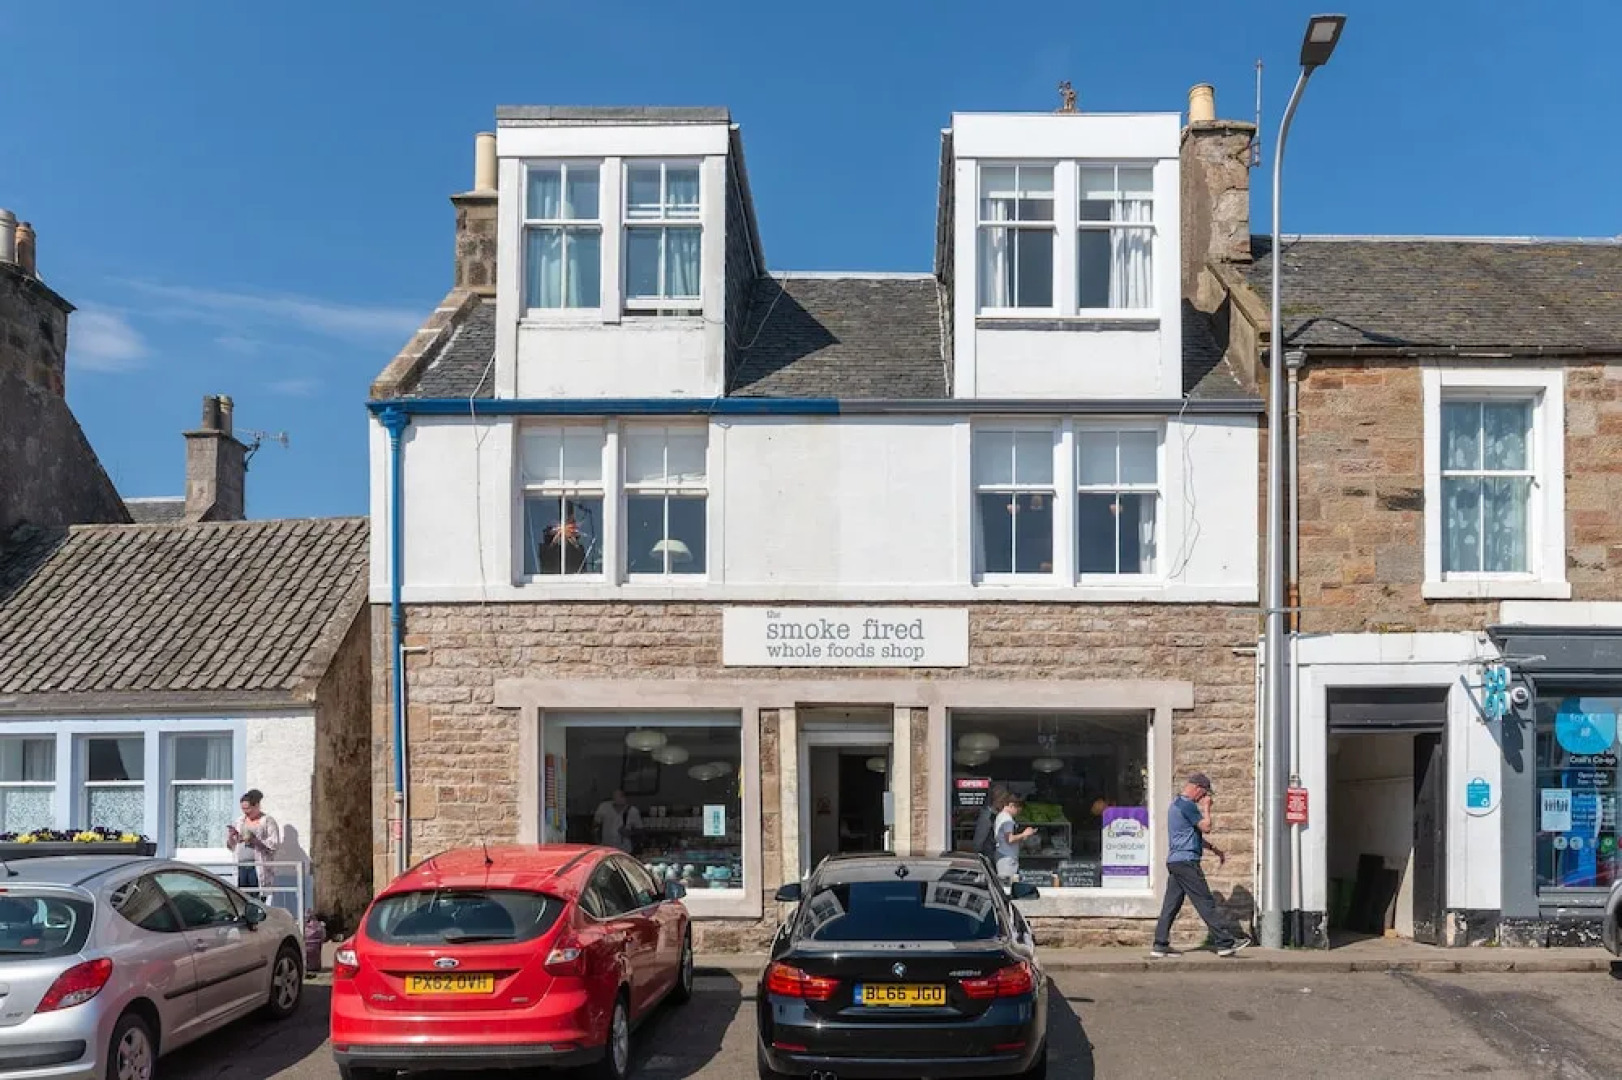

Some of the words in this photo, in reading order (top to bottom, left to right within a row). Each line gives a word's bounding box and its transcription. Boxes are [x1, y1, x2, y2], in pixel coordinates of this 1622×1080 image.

[766, 610, 781, 619] the
[766, 618, 850, 640] smoke
[862, 618, 924, 640] fired
[766, 643, 822, 658] whole
[827, 643, 875, 658] foods
[881, 643, 925, 662] shop
[1105, 841, 1146, 851] available
[1114, 852, 1136, 860] here
[411, 975, 453, 990] PX62
[456, 975, 487, 989] OVH
